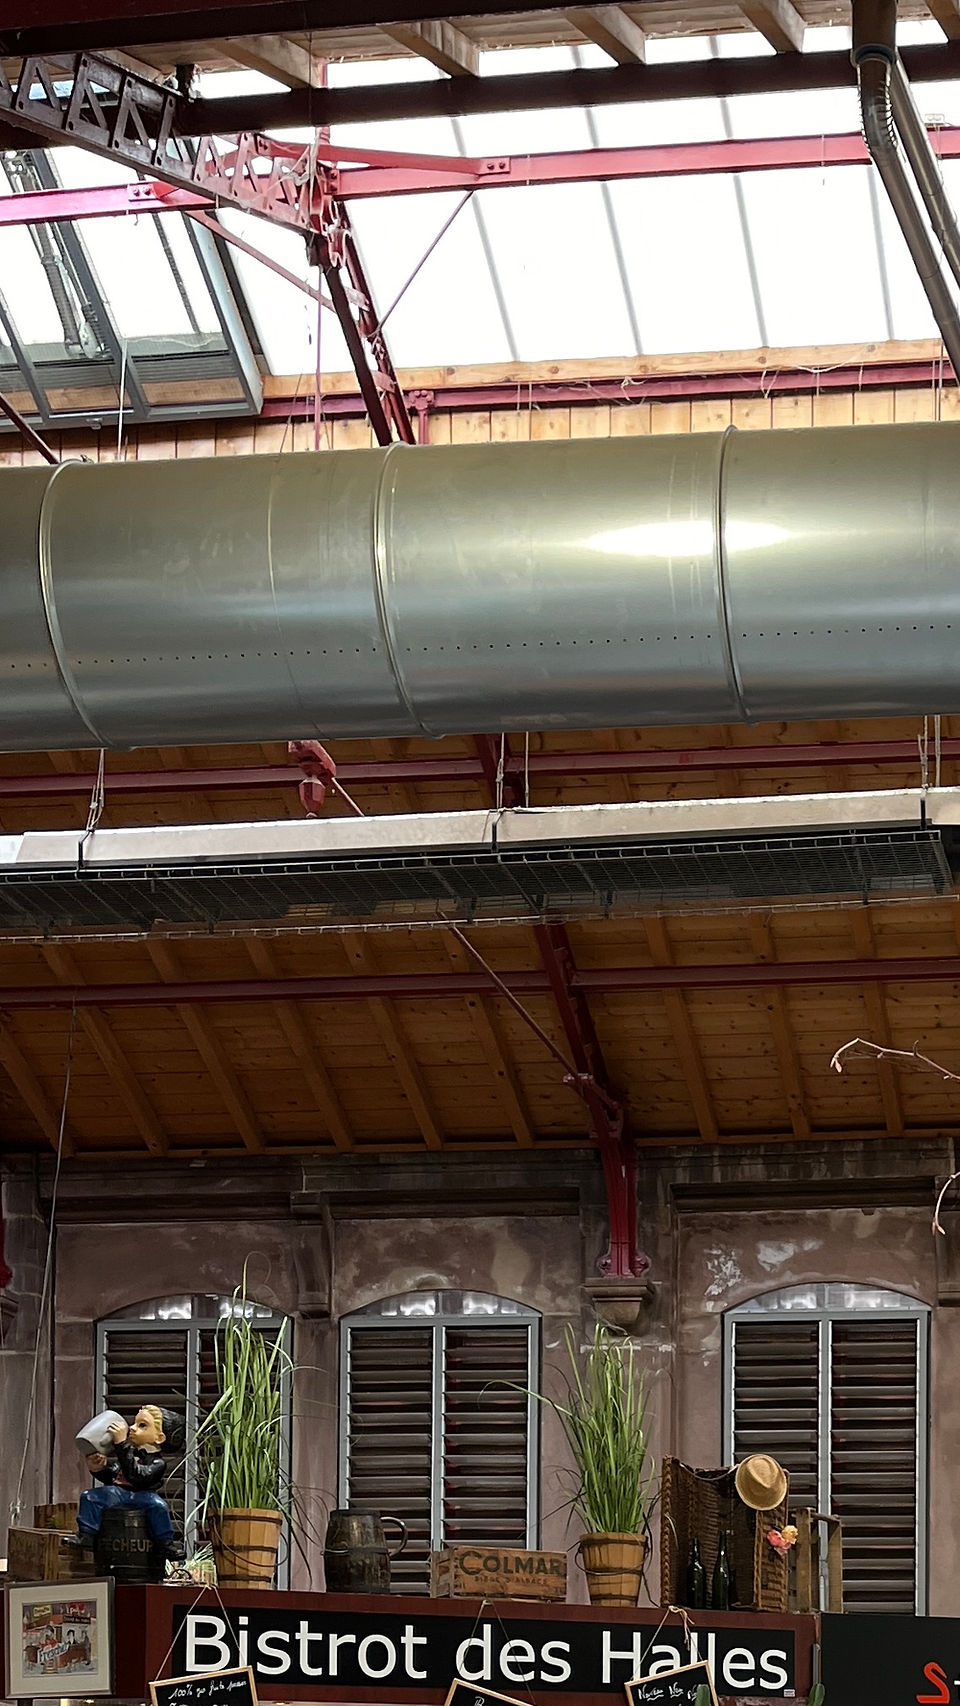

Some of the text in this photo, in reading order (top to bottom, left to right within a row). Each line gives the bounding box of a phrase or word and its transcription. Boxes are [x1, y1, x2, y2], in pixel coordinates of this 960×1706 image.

[459, 1551, 564, 1577] COLMAR
[185, 1614, 788, 1690] Bistrot des Halles
